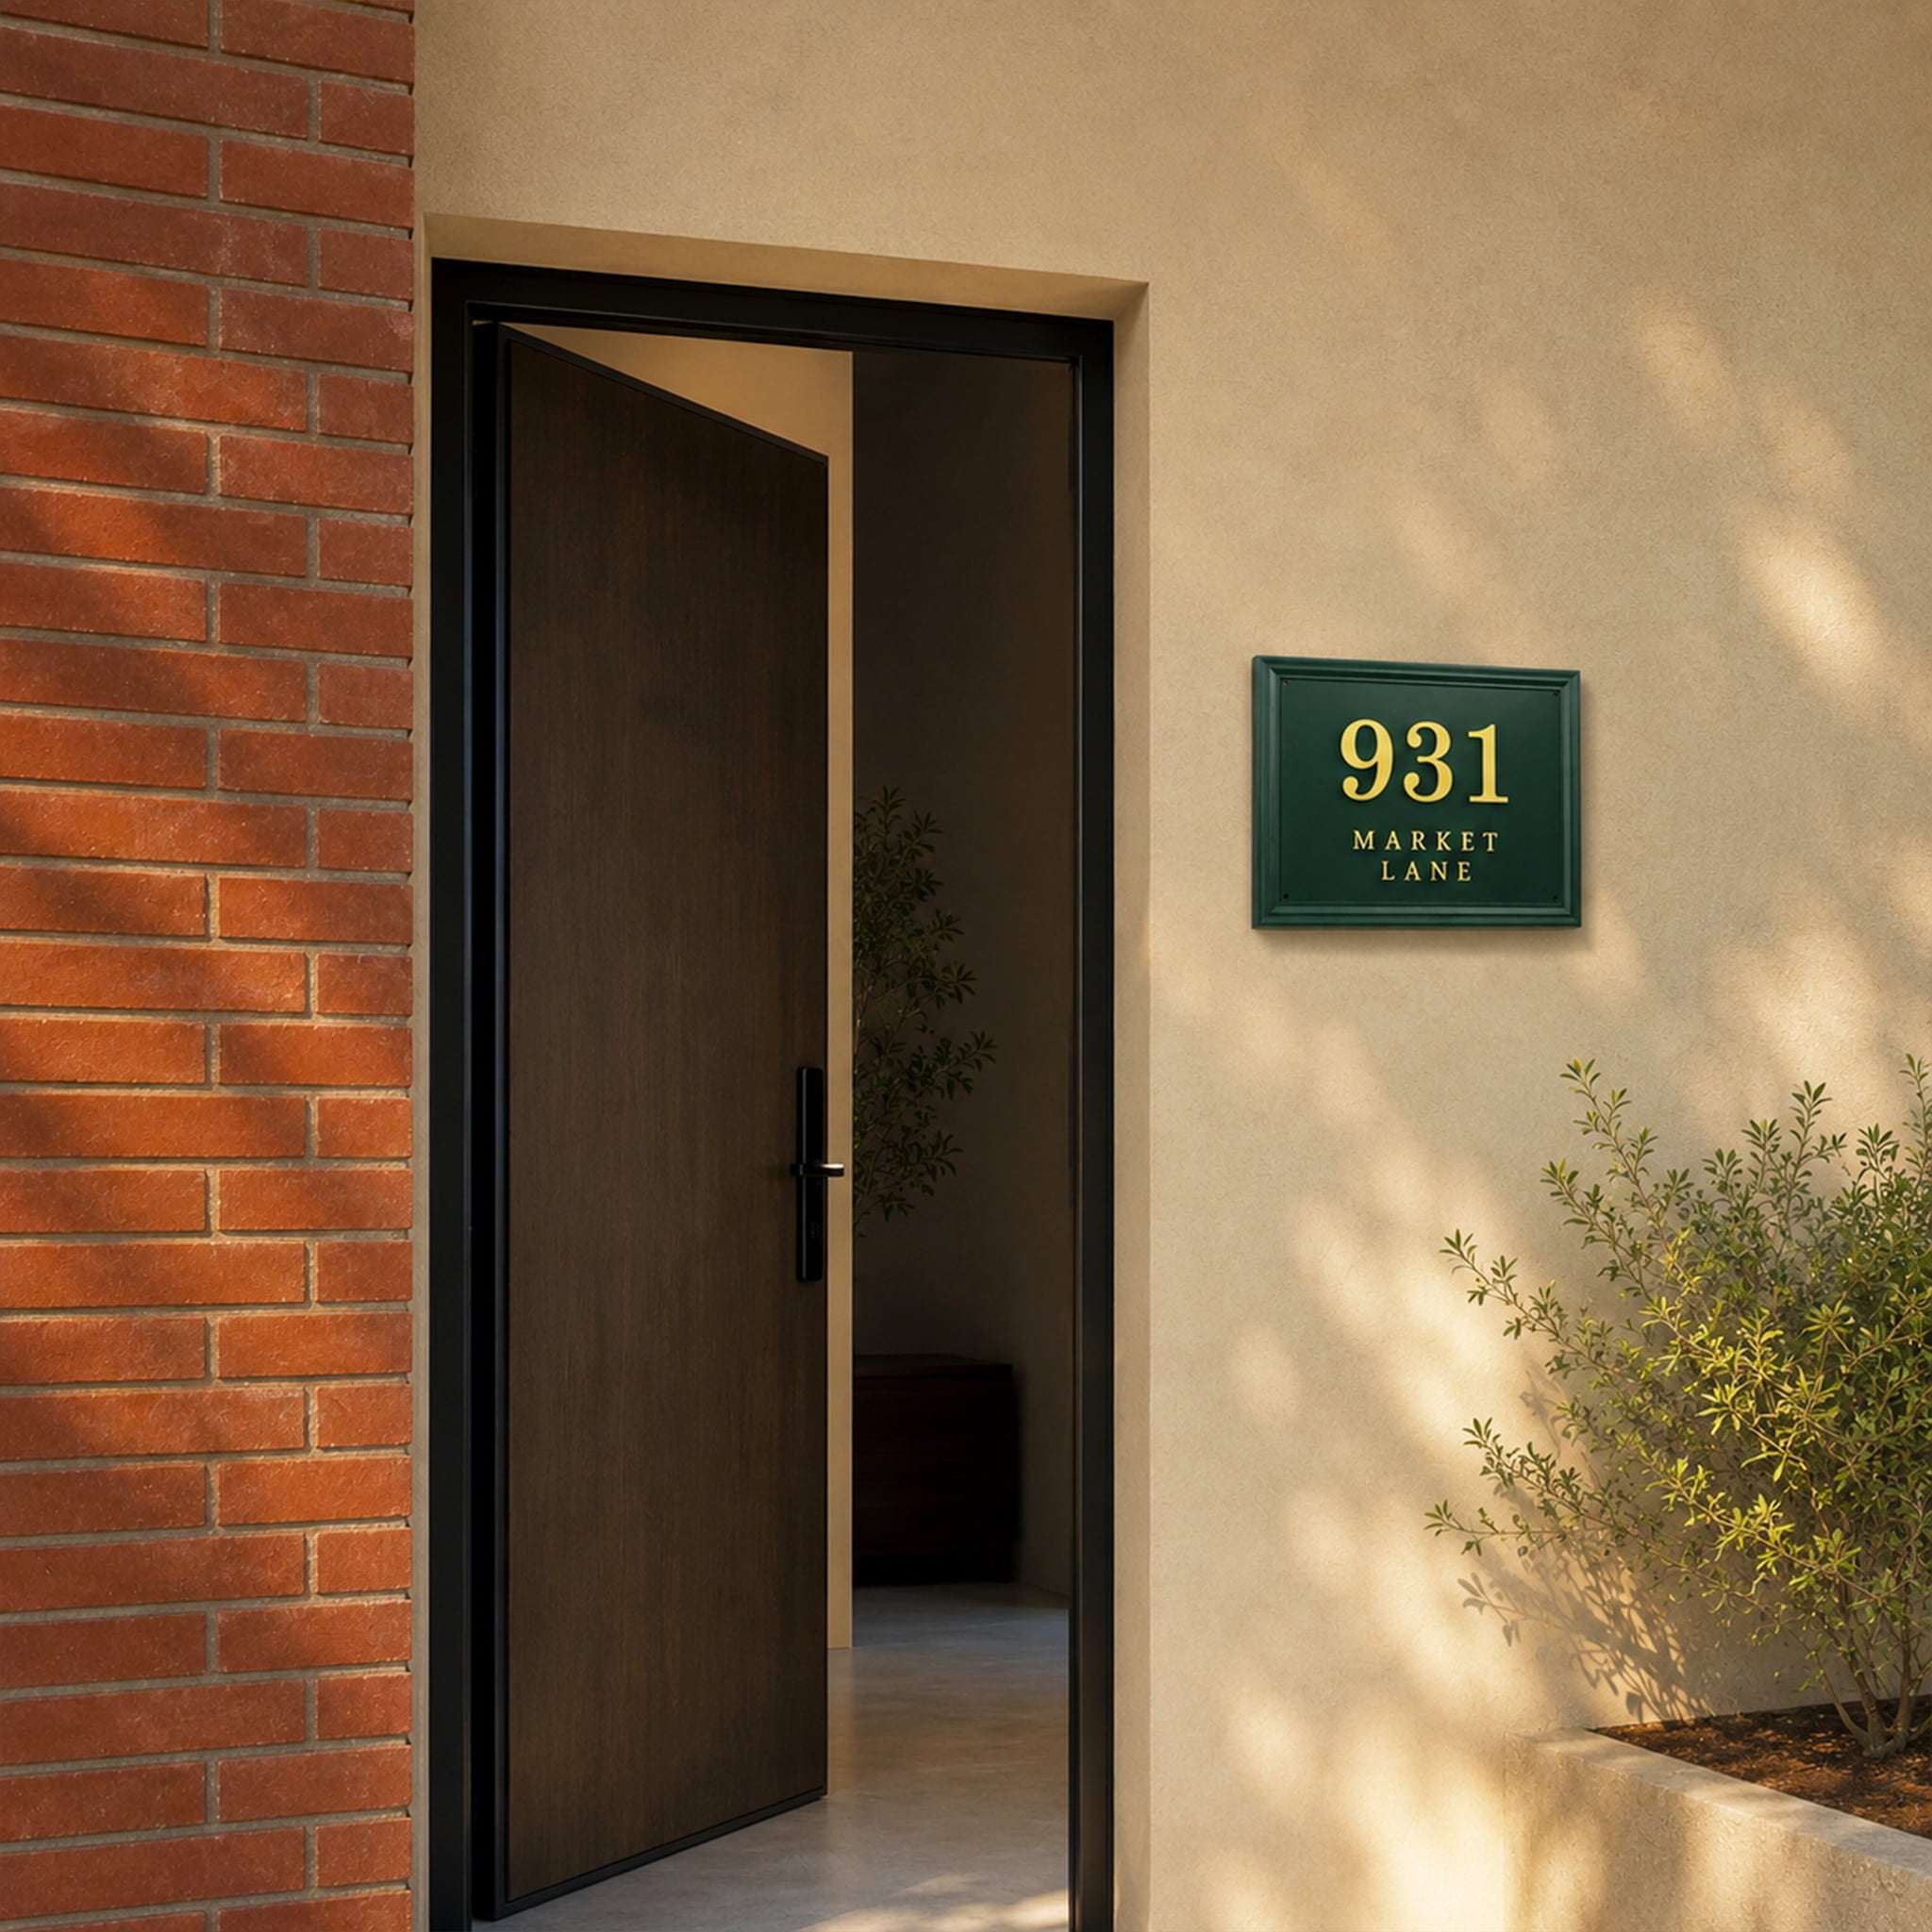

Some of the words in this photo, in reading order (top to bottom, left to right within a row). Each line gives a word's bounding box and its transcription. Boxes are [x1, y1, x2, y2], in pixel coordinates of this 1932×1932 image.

[1340, 718, 1509, 804] 931
[1353, 829, 1499, 852] MARKET
[1381, 860, 1472, 881] LANE
